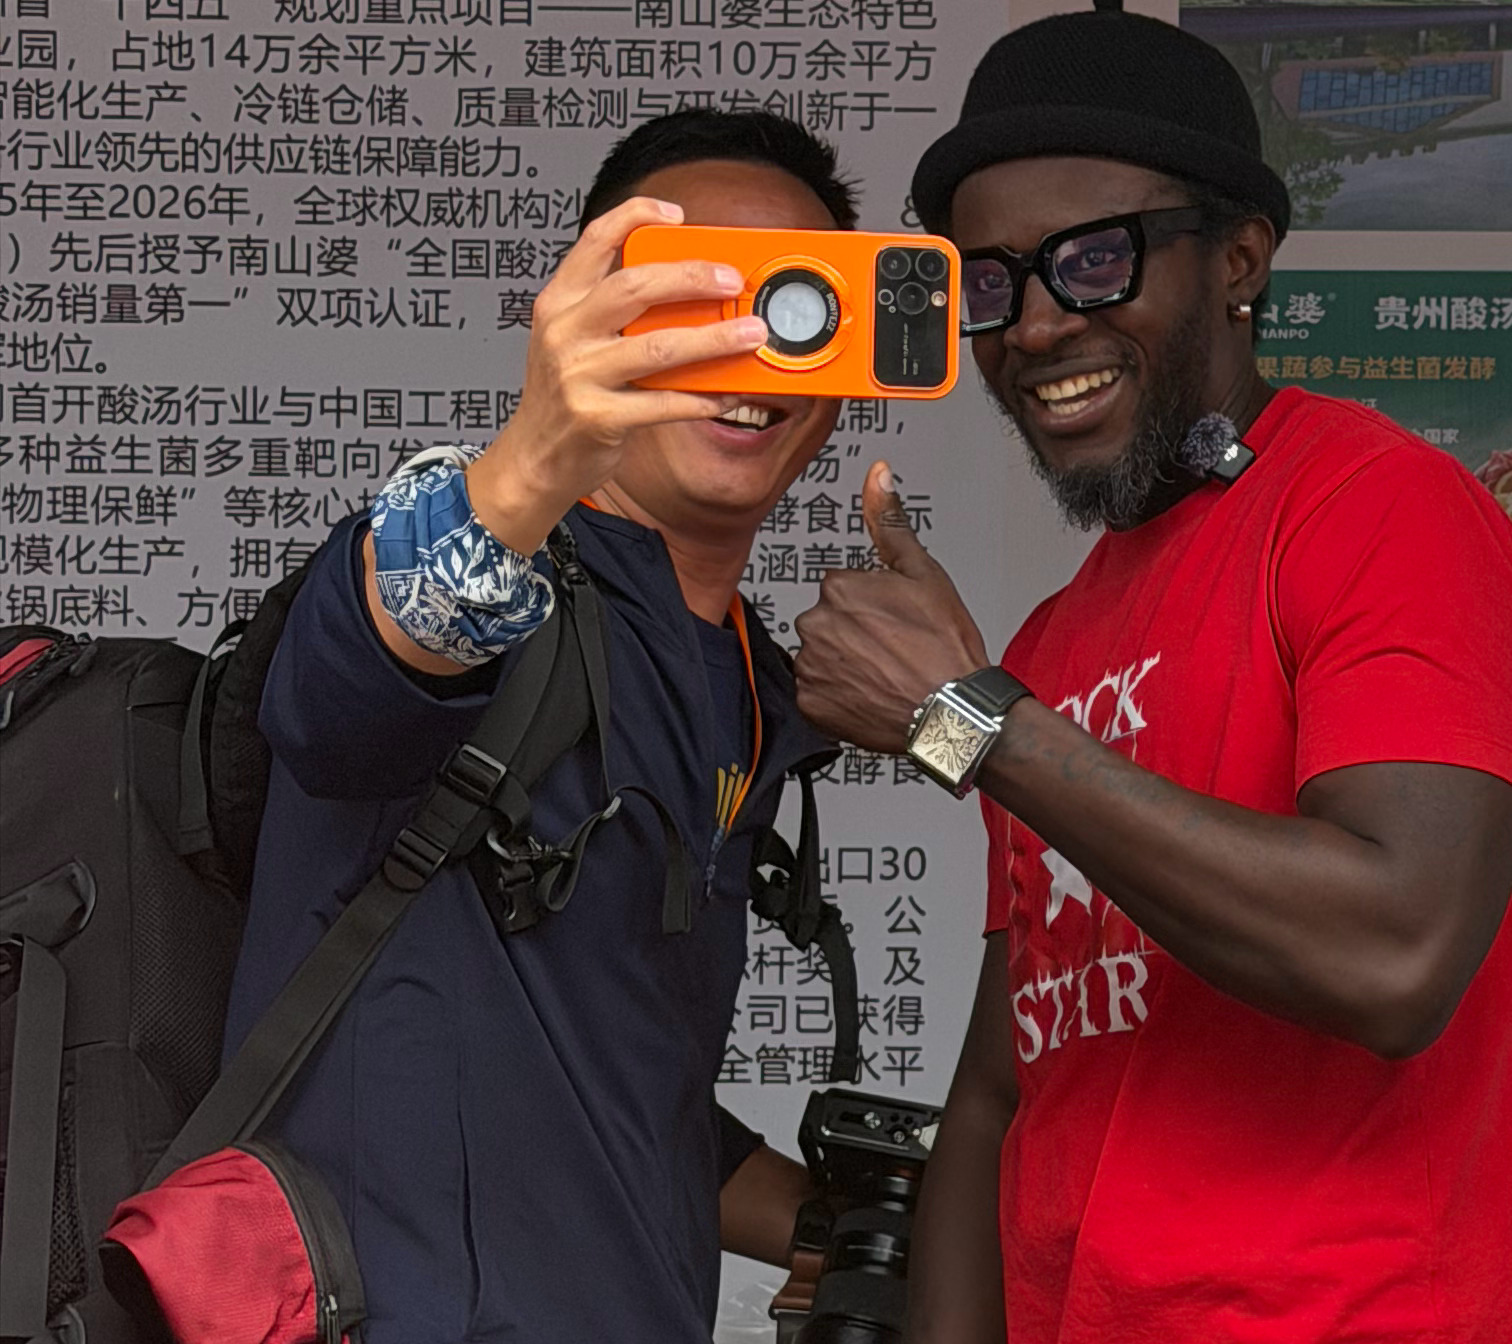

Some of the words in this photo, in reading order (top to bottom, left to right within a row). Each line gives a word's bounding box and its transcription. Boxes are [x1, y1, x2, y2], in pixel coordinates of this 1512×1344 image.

[0, 78, 938, 132] 能化生产、冷链仓储、质量检测与研发创新于一
[0, 128, 540, 179] 行业领先的供应链保障能力。
[0, 282, 541, 331] 汤销量第一”双项认证，奠
[0, 331, 108, 375] 地位。
[0, 382, 524, 431] 首开酸汤行业与中国工程院
[835, 399, 904, 435] 制，
[0, 584, 262, 629] 锅底料、方便
[731, 993, 926, 1036] 司已获得
[1012, 952, 1149, 1064] STAR
